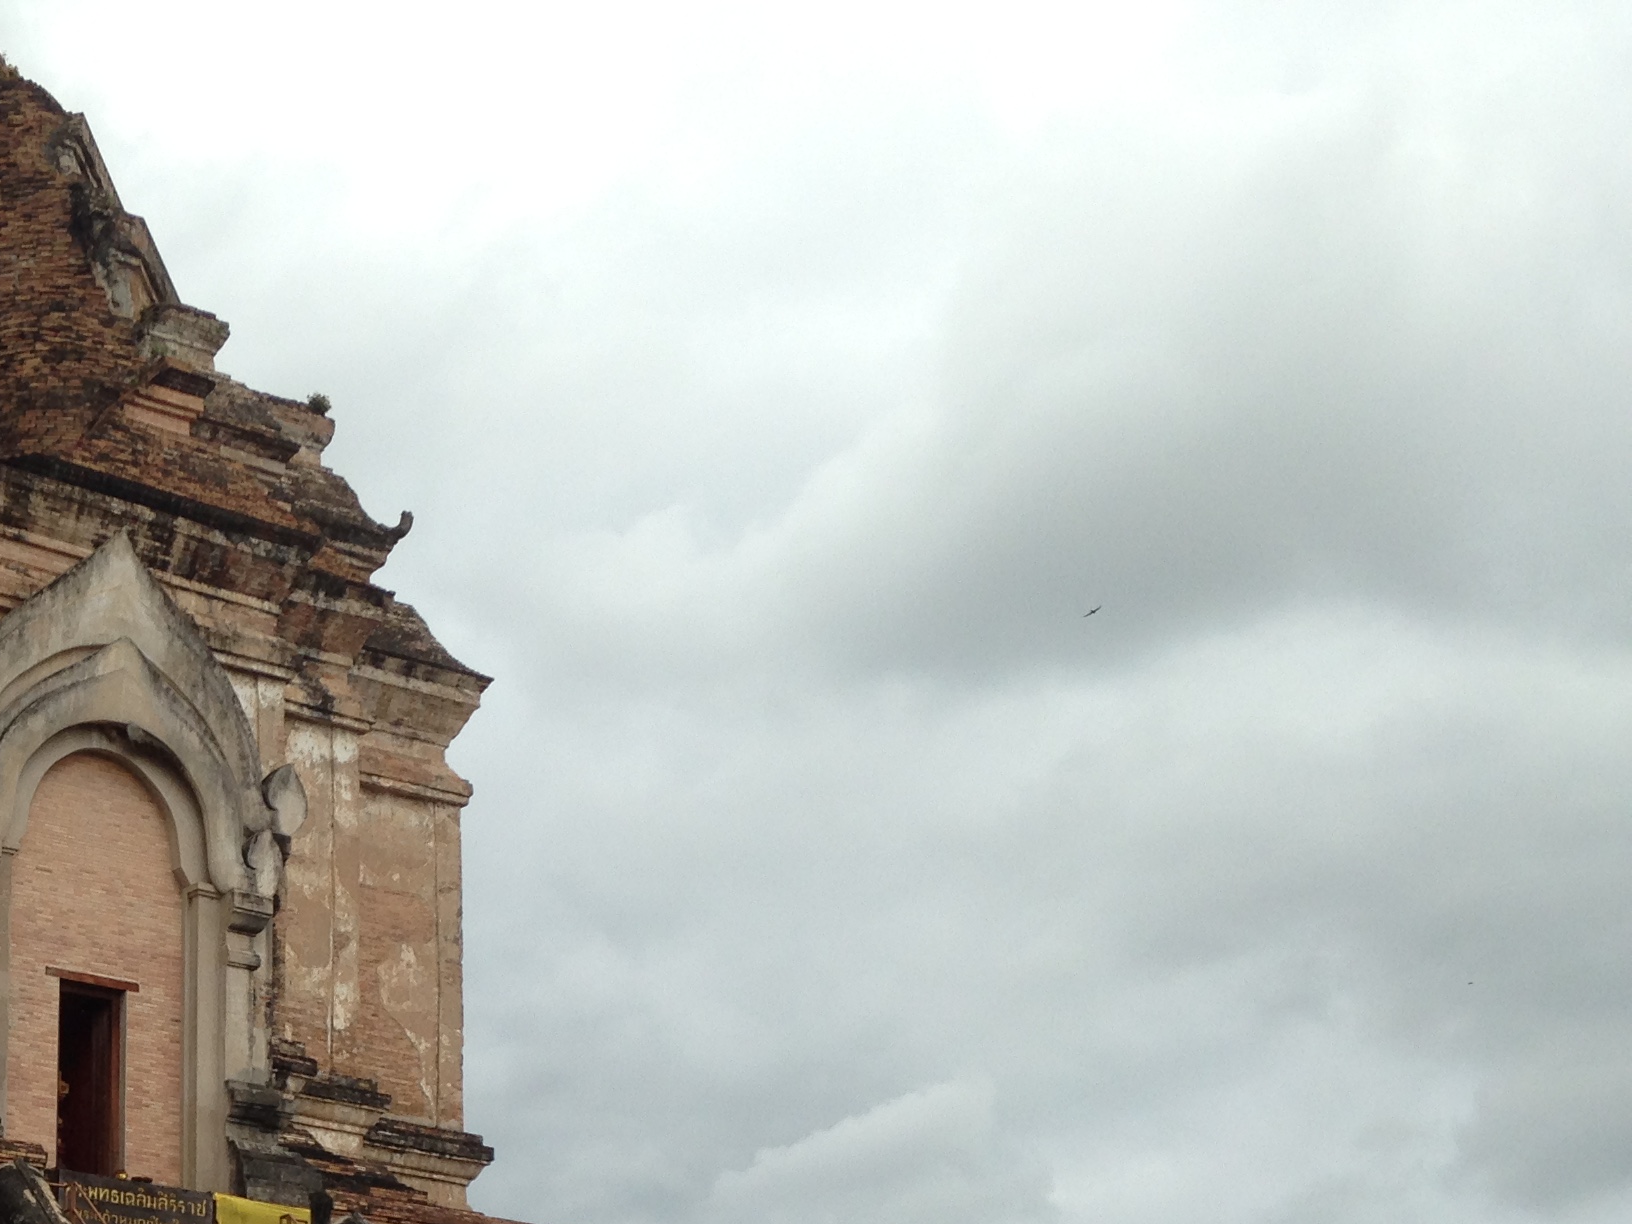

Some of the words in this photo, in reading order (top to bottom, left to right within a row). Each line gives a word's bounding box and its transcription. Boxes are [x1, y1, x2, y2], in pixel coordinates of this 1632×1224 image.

[76, 1186, 206, 1217] ะพุทธเฉลิมสิริราช
